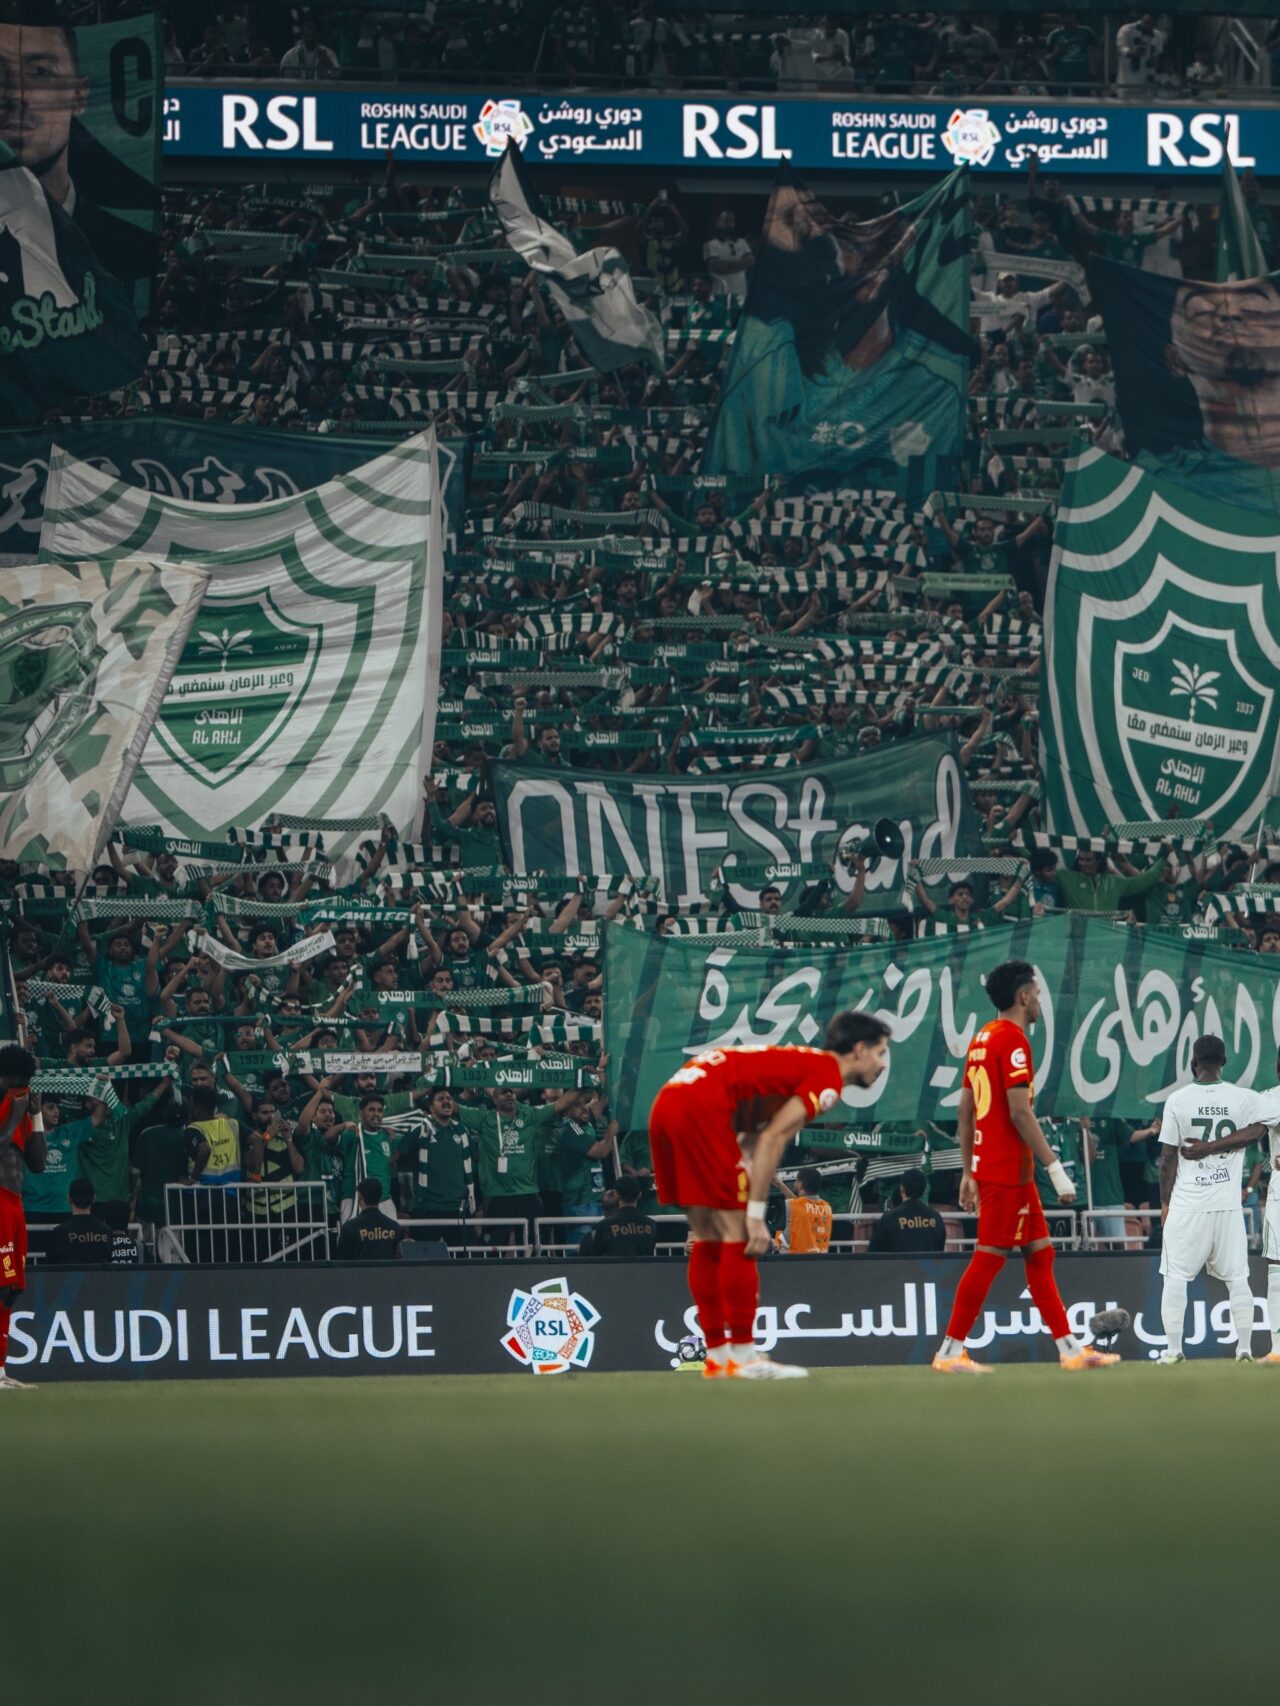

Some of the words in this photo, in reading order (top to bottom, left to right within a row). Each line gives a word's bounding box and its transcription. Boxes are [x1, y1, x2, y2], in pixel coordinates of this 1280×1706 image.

[361, 103, 416, 119] ROSHN
[419, 104, 467, 120] SAUDI
[538, 101, 592, 124] روشن
[595, 107, 642, 129] دوري
[832, 112, 886, 127] ROSHN
[890, 113, 936, 128] SAUDI
[222, 94, 333, 151] RSL
[683, 104, 793, 159] RSL
[1005, 111, 1059, 133] روشن
[1061, 117, 1108, 139] دوري
[361, 123, 467, 150] LEAGUE
[538, 129, 642, 159] السعودي
[832, 132, 936, 160] LEAGUE
[1147, 113, 1256, 167] RSL
[1005, 138, 1108, 168] السعودي
[229, 676, 266, 693] الزمان
[267, 672, 295, 691] وعبر
[1132, 667, 1150, 683] JED
[178, 680, 226, 699] سنمضي
[1235, 701, 1256, 716] 1937
[192, 729, 209, 745] AL
[211, 729, 241, 745] AHLI
[1195, 731, 1226, 751] الزمان
[1227, 737, 1249, 756] وعبر
[1155, 778, 1172, 796] AL
[1173, 783, 1202, 806] AHLI
[383, 910, 409, 922] FC
[1198, 1106, 1229, 1116] KESSIE
[611, 1223, 652, 1238] Police
[899, 1216, 937, 1230] Police
[68, 1231, 108, 1243] Police
[359, 1228, 396, 1242] Police
[112, 1246, 137, 1257] uard
[534, 1319, 569, 1337] RSL
[654, 1281, 937, 1369] السعوي
[6, 1308, 189, 1366] SAUDI
[209, 1304, 437, 1361] LEAGUE
